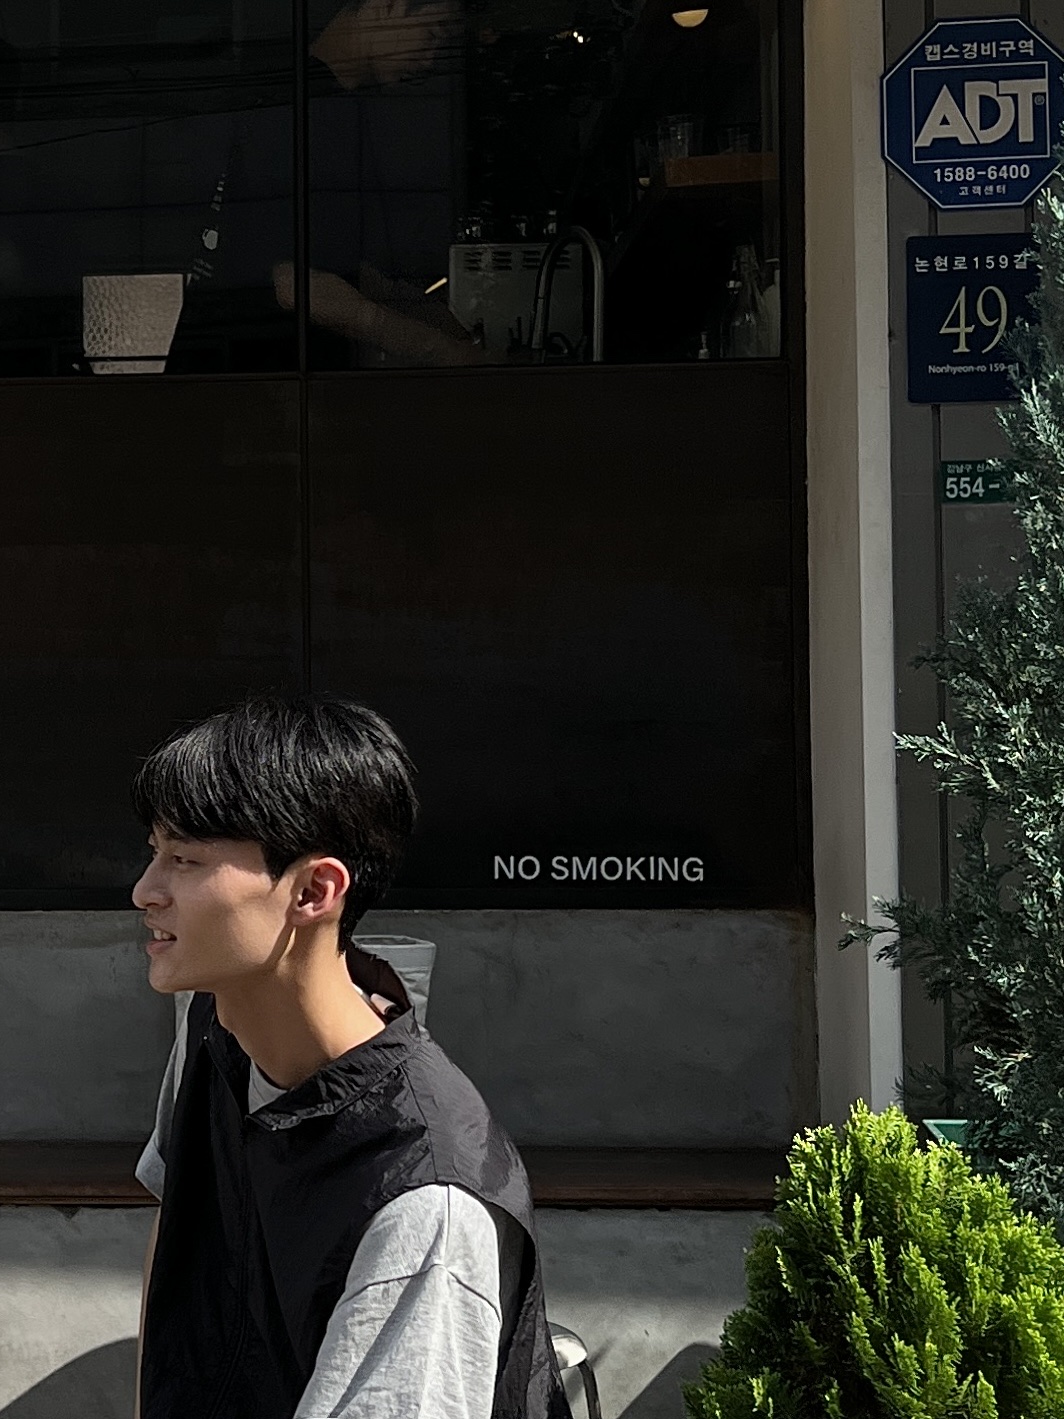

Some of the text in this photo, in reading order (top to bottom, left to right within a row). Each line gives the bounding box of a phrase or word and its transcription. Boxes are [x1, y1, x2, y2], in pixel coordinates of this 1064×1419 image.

[925, 39, 1035, 61] 캡스경비구역
[914, 78, 1047, 147] ADT
[934, 164, 1030, 182] 1588-6400
[959, 184, 1006, 196] 고객센터
[939, 285, 1008, 354] 49
[928, 363, 987, 375] Nonhyeon-ro
[494, 855, 704, 881] NO SMOKING
